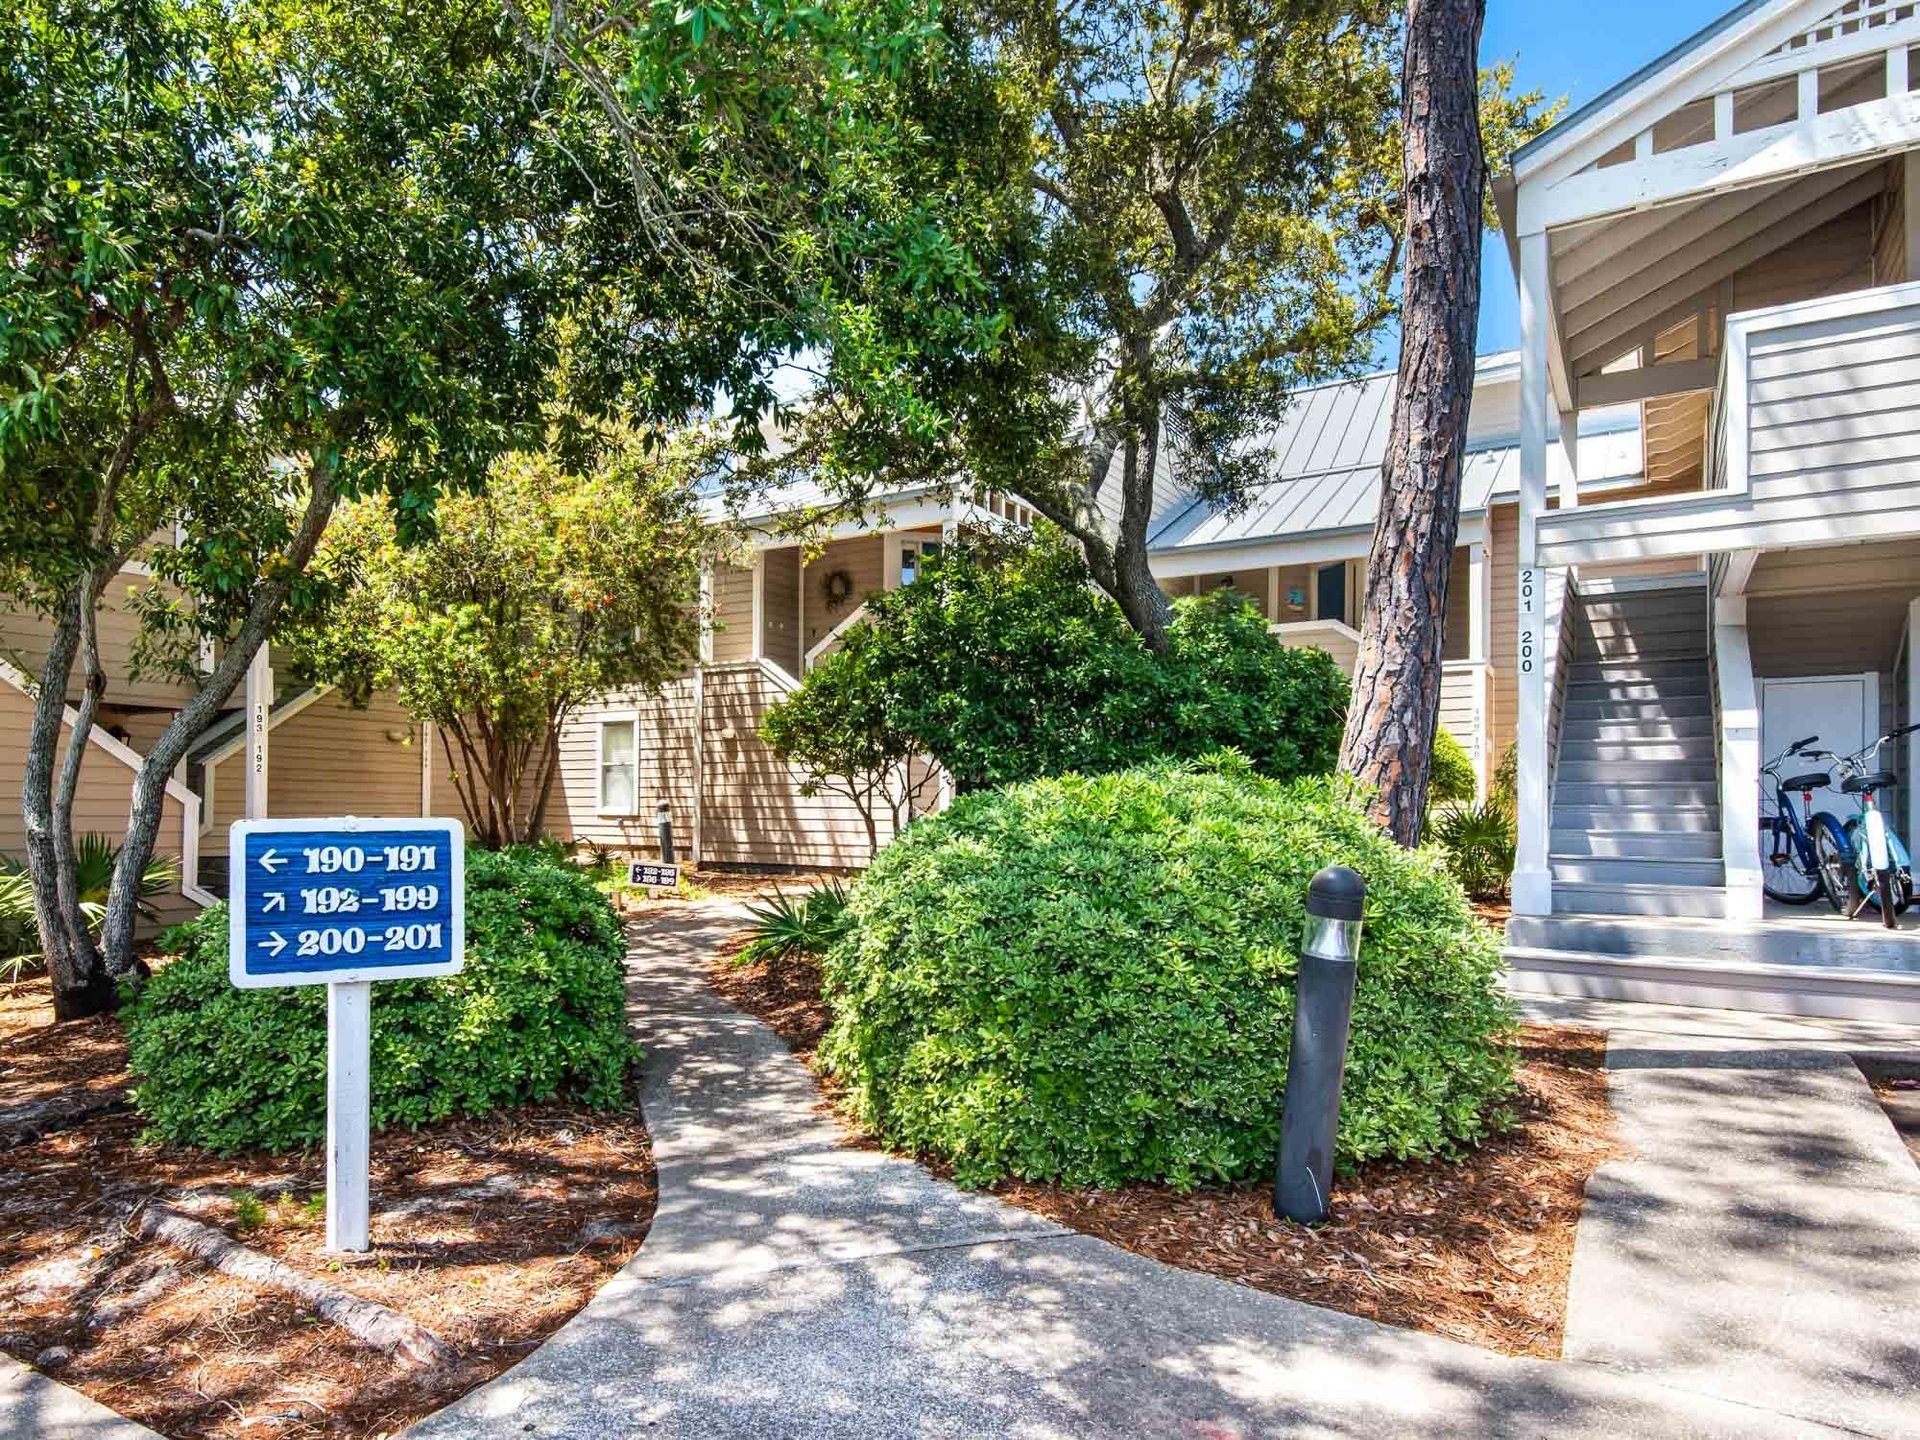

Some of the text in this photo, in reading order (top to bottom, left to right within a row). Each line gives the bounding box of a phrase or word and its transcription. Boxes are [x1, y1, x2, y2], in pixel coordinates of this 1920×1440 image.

[1522, 570, 1533, 672] 201 200
[303, 846, 436, 874] 190-191
[299, 885, 439, 914] 192-199
[296, 923, 442, 956] 200-201
